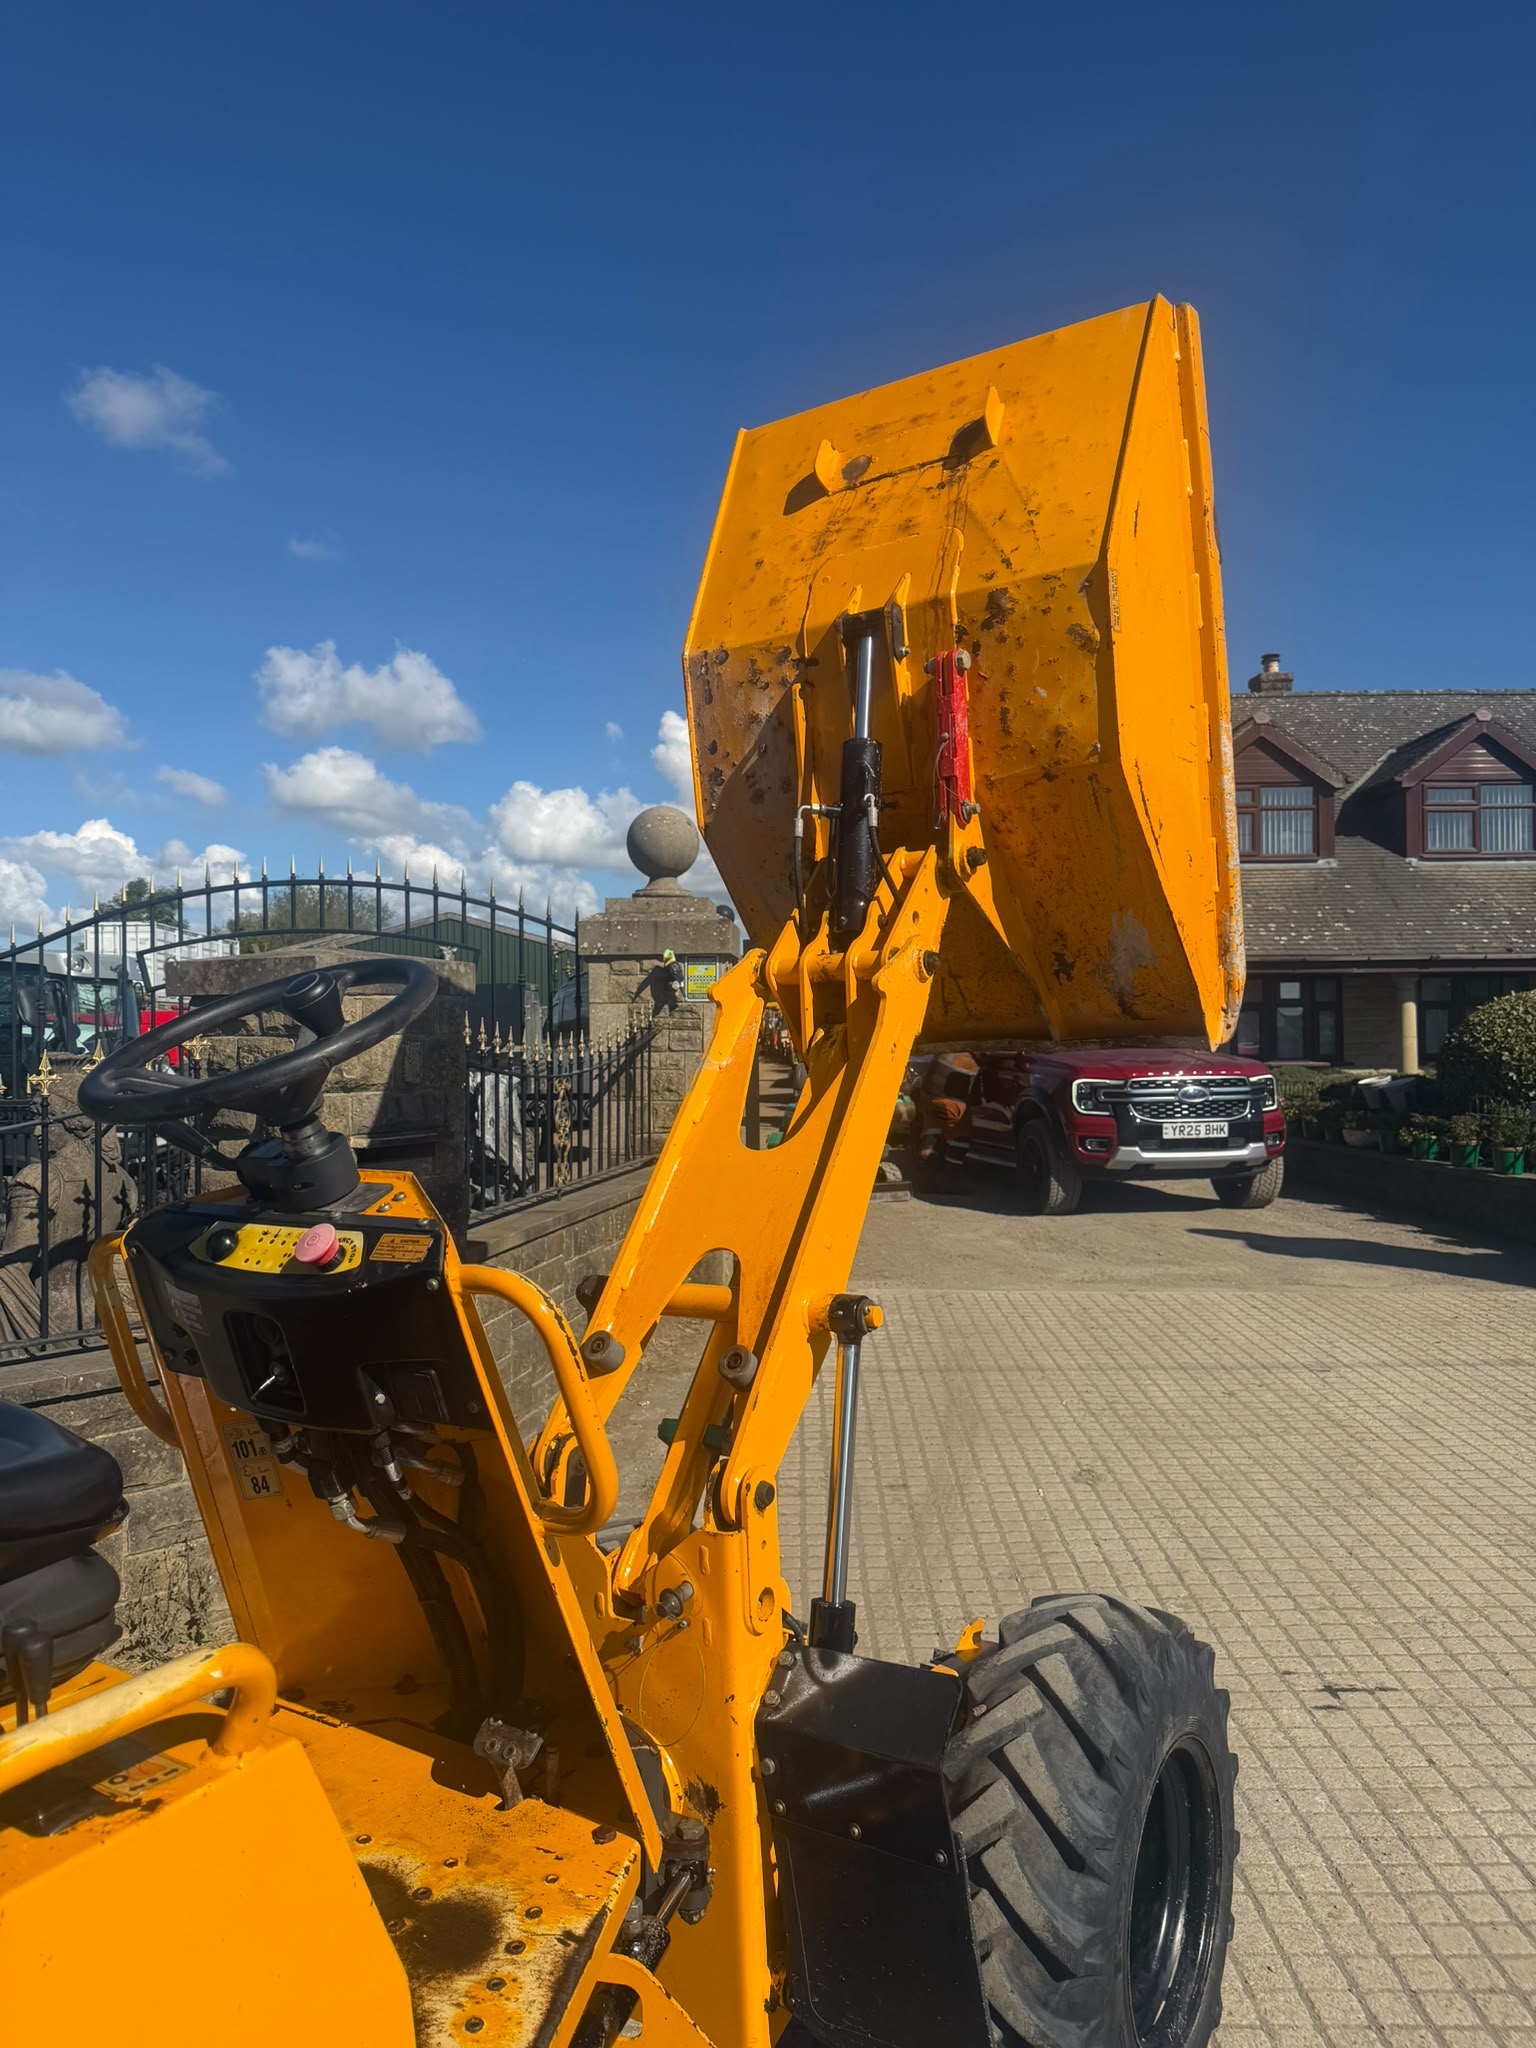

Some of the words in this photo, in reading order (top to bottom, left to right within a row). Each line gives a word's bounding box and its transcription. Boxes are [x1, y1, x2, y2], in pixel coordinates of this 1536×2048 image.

[1171, 1124, 1202, 1136] YR25
[1204, 1123, 1226, 1136] BHK
[232, 1439, 258, 1459] 101
[251, 1475, 270, 1494] 84
